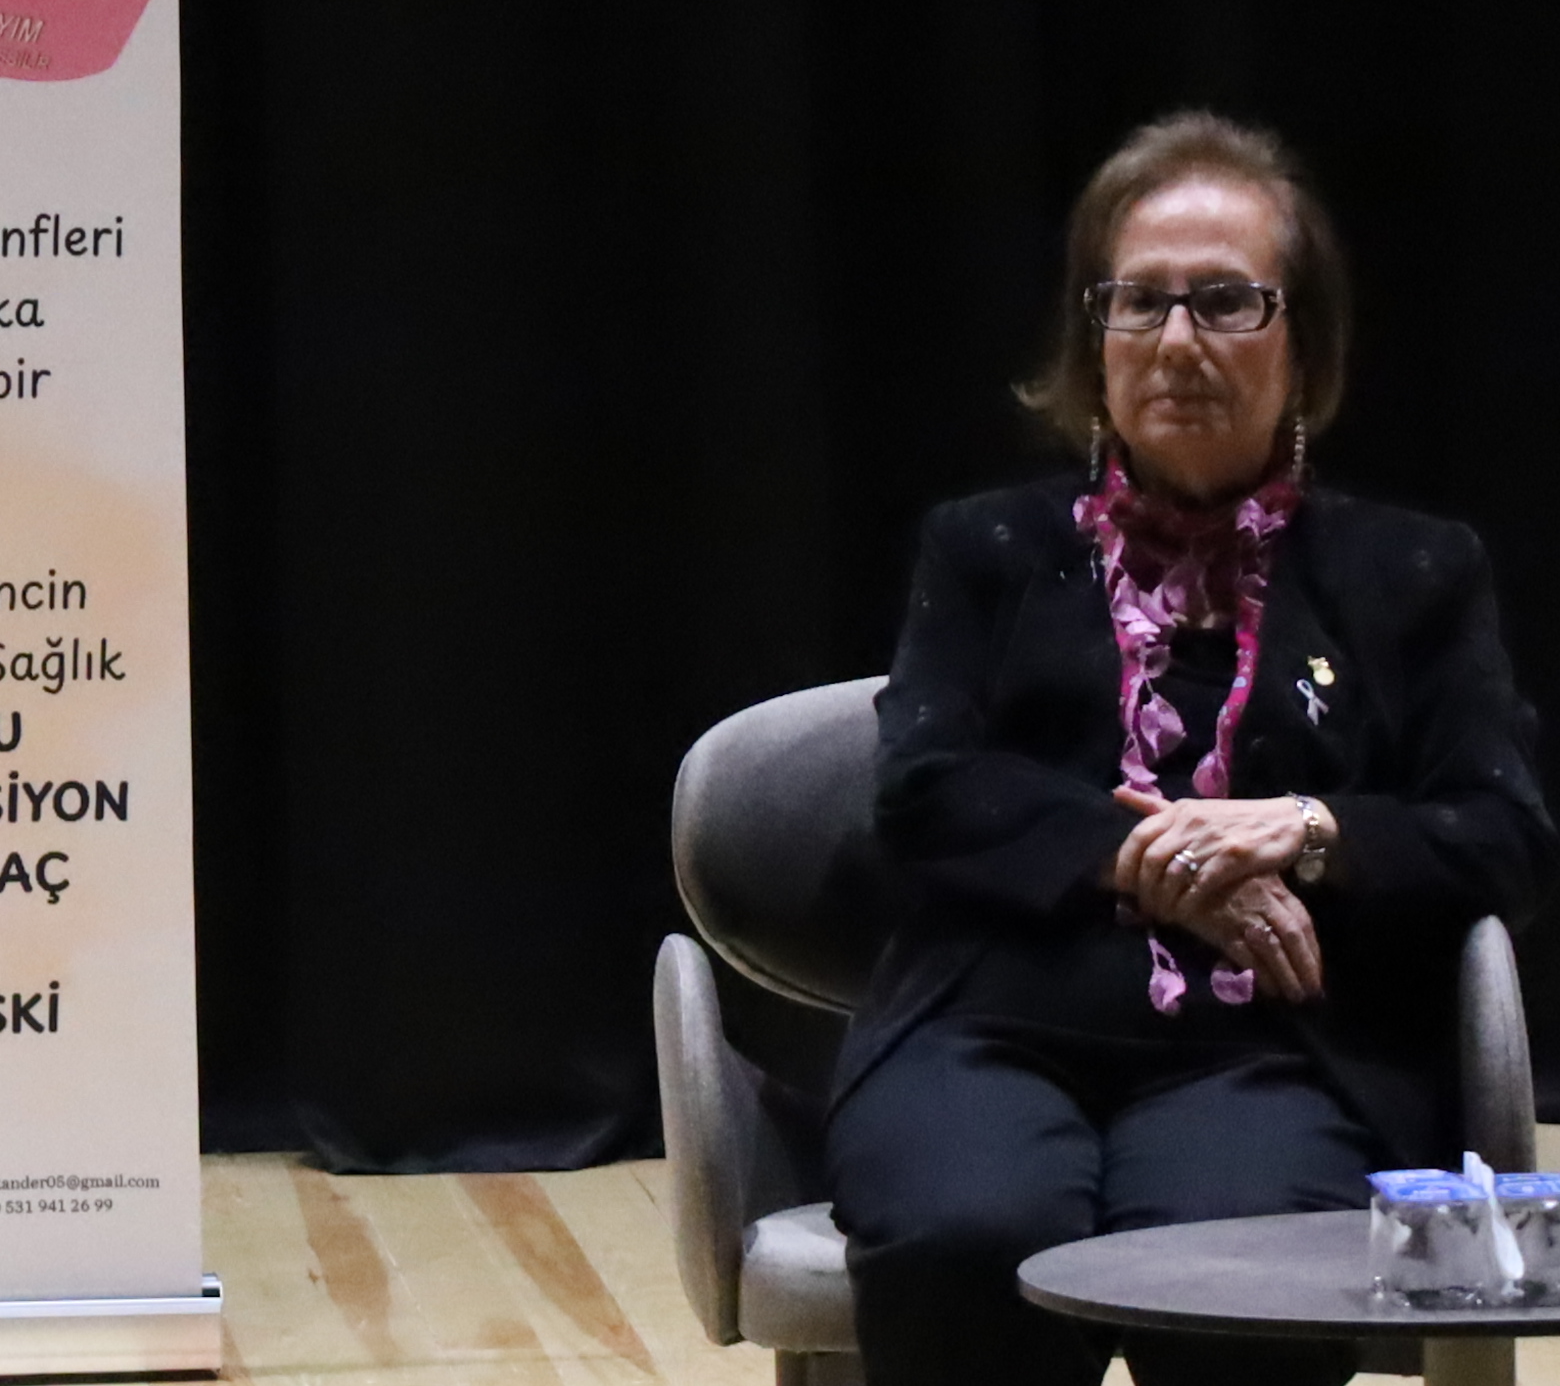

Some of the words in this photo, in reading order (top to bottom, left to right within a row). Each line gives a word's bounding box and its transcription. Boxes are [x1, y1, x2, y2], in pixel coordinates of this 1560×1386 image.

[5, 1200, 33, 1214] 531
[38, 1199, 66, 1213] 941
[71, 1199, 90, 1212] 26
[94, 1199, 114, 1211] 99
